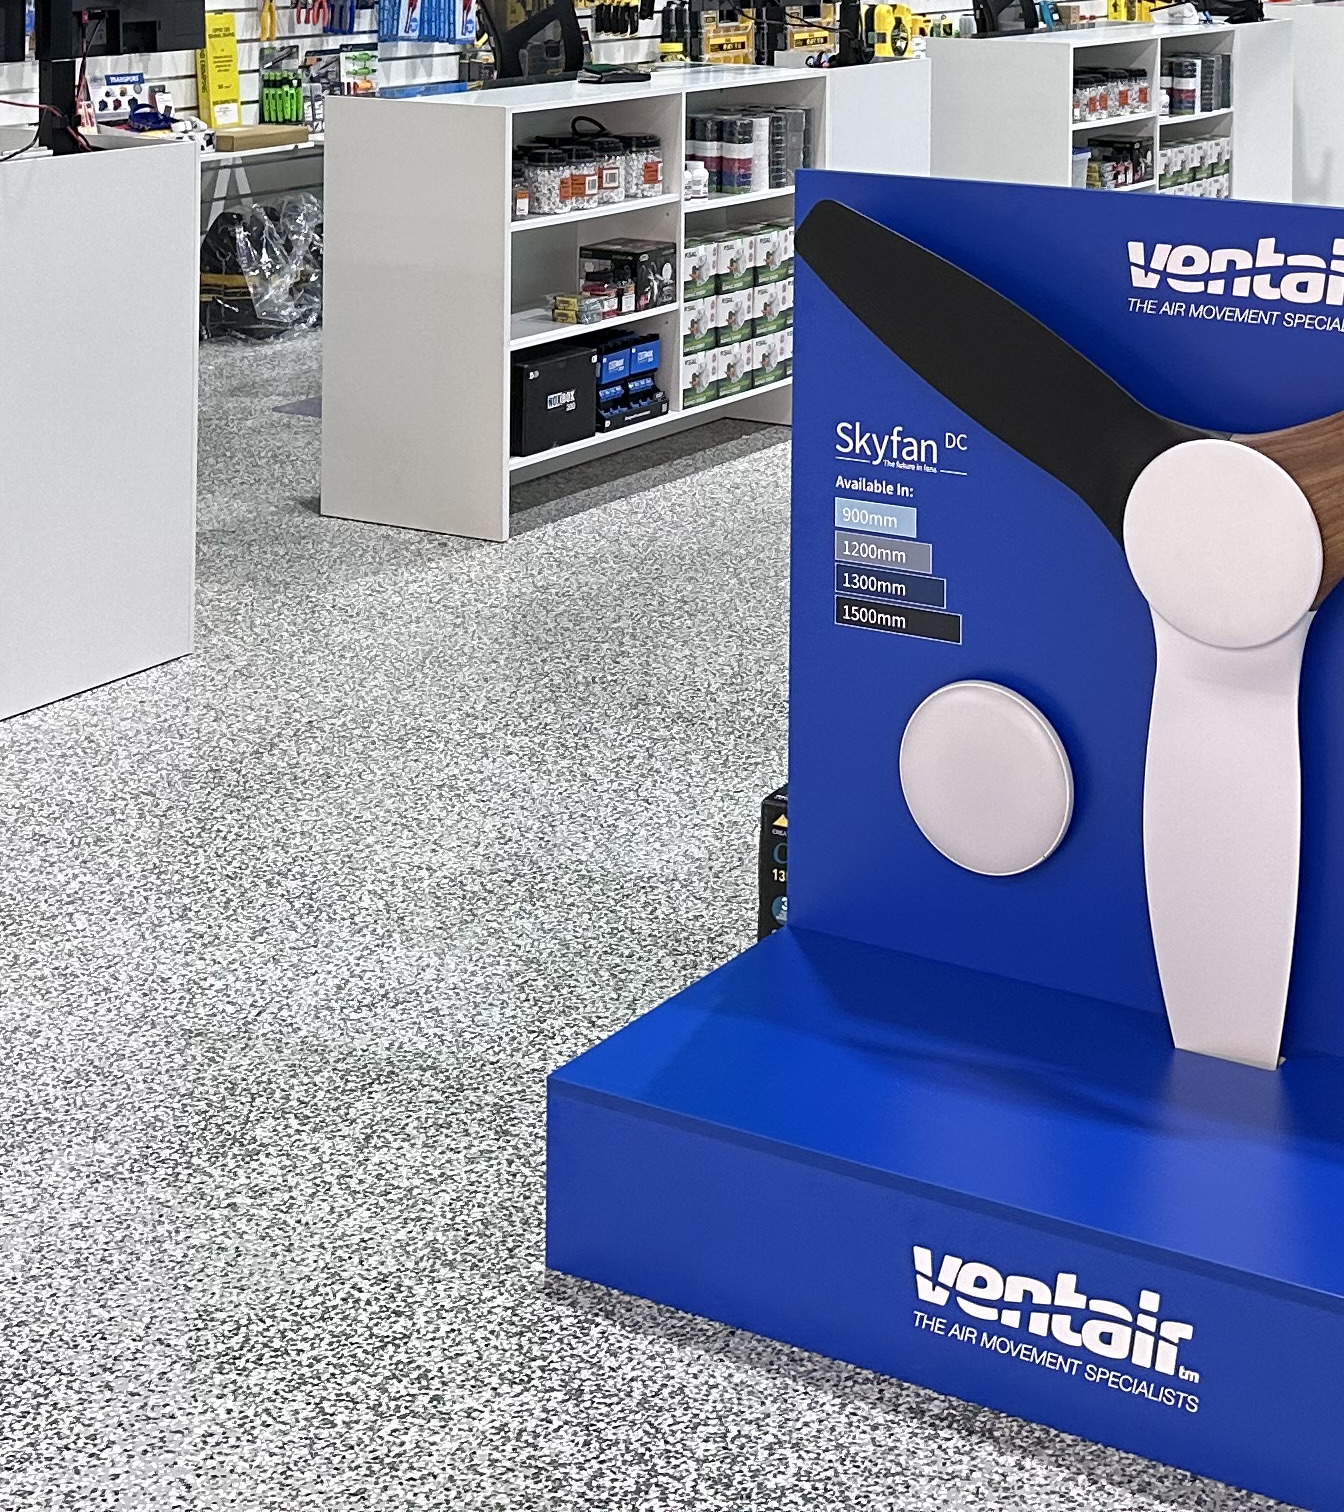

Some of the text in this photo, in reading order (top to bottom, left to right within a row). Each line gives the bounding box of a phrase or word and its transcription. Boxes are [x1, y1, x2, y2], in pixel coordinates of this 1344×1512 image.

[1128, 297, 1158, 314] THE
[1159, 301, 1185, 317] AIR
[1188, 303, 1281, 326] MOVEMENT
[835, 421, 968, 465] Skyfan DC
[835, 475, 914, 498] Available In:
[842, 507, 898, 529] 900mm
[842, 539, 907, 564] 1200mm
[842, 571, 907, 597] 1300mm
[842, 604, 907, 630] 1500mm
[913, 1245, 1200, 1384] ventair tm
[913, 1310, 1200, 1414] THE AIR MOVEMENT SPECIALISTS
